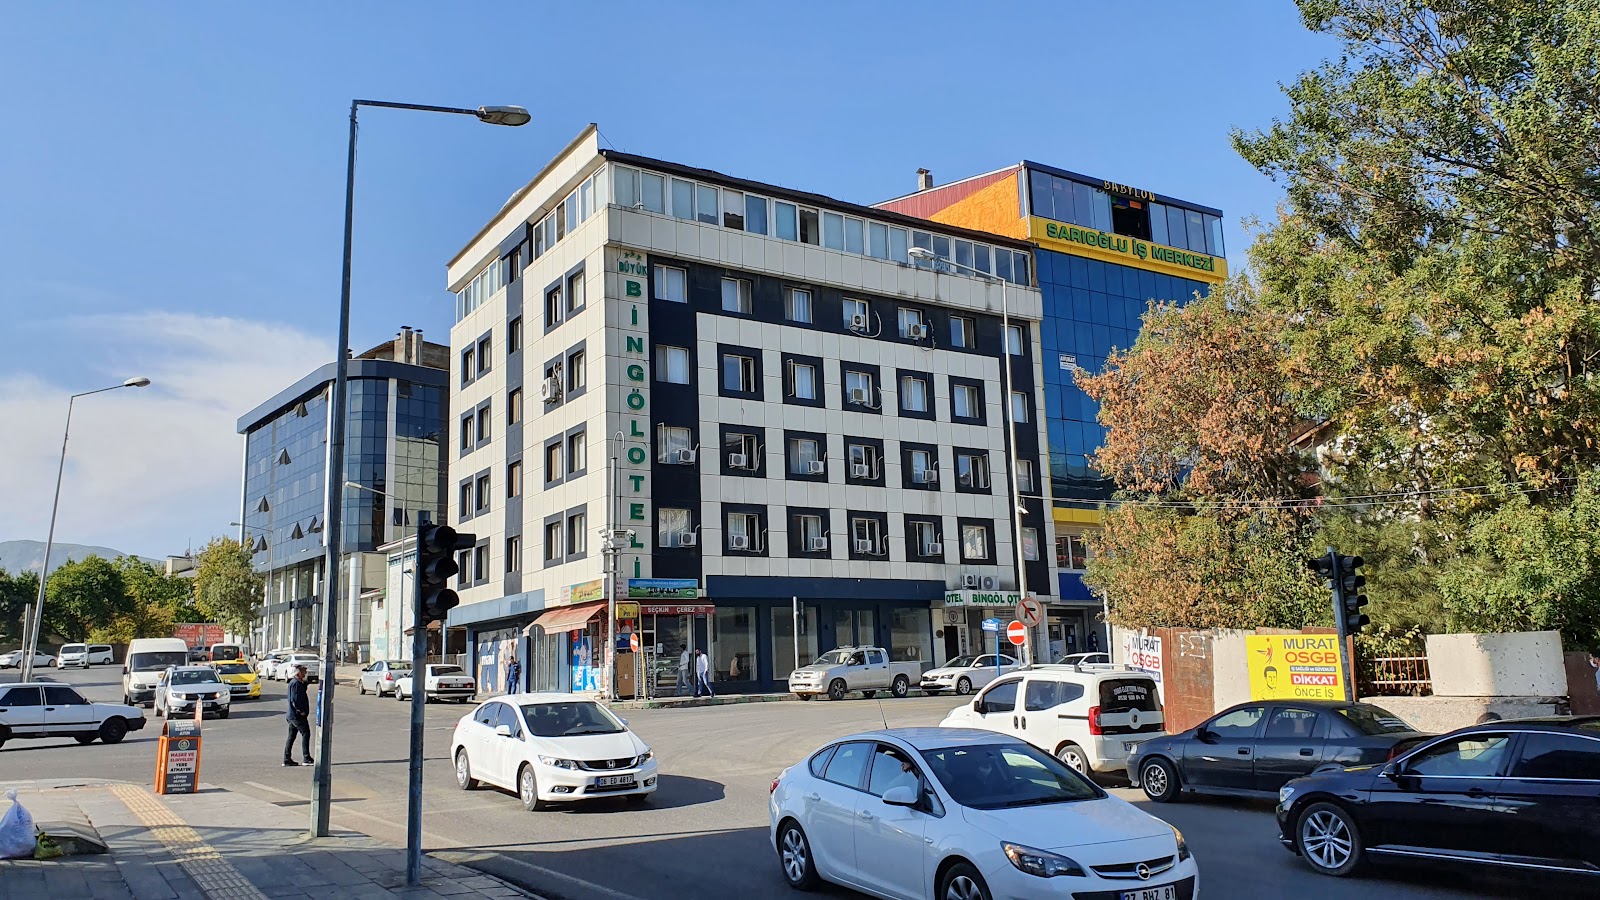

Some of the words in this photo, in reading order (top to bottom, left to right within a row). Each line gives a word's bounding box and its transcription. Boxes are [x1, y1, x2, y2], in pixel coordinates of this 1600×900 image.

[1103, 180, 1156, 202] BABYLON
[1046, 222, 1129, 253] SARIOĞLU
[1132, 238, 1148, 260] İŞ
[1151, 245, 1215, 272] MERKEZİ
[946, 593, 964, 604] OTEL
[972, 592, 1005, 604] BİNGÖL
[647, 606, 669, 614] SEÇKİN
[677, 606, 696, 614] ÇEREZ
[1131, 636, 1161, 653] MURAT
[1283, 638, 1336, 650] MURAT
[481, 651, 495, 666] mavi
[1131, 652, 1161, 669] OSGB
[1284, 651, 1338, 664] OSGB
[1292, 673, 1335, 685] DİKKAT
[1294, 686, 1322, 697] ÖNCE
[1324, 687, 1335, 699] İŞ
[1165, 886, 1175, 900] 81
